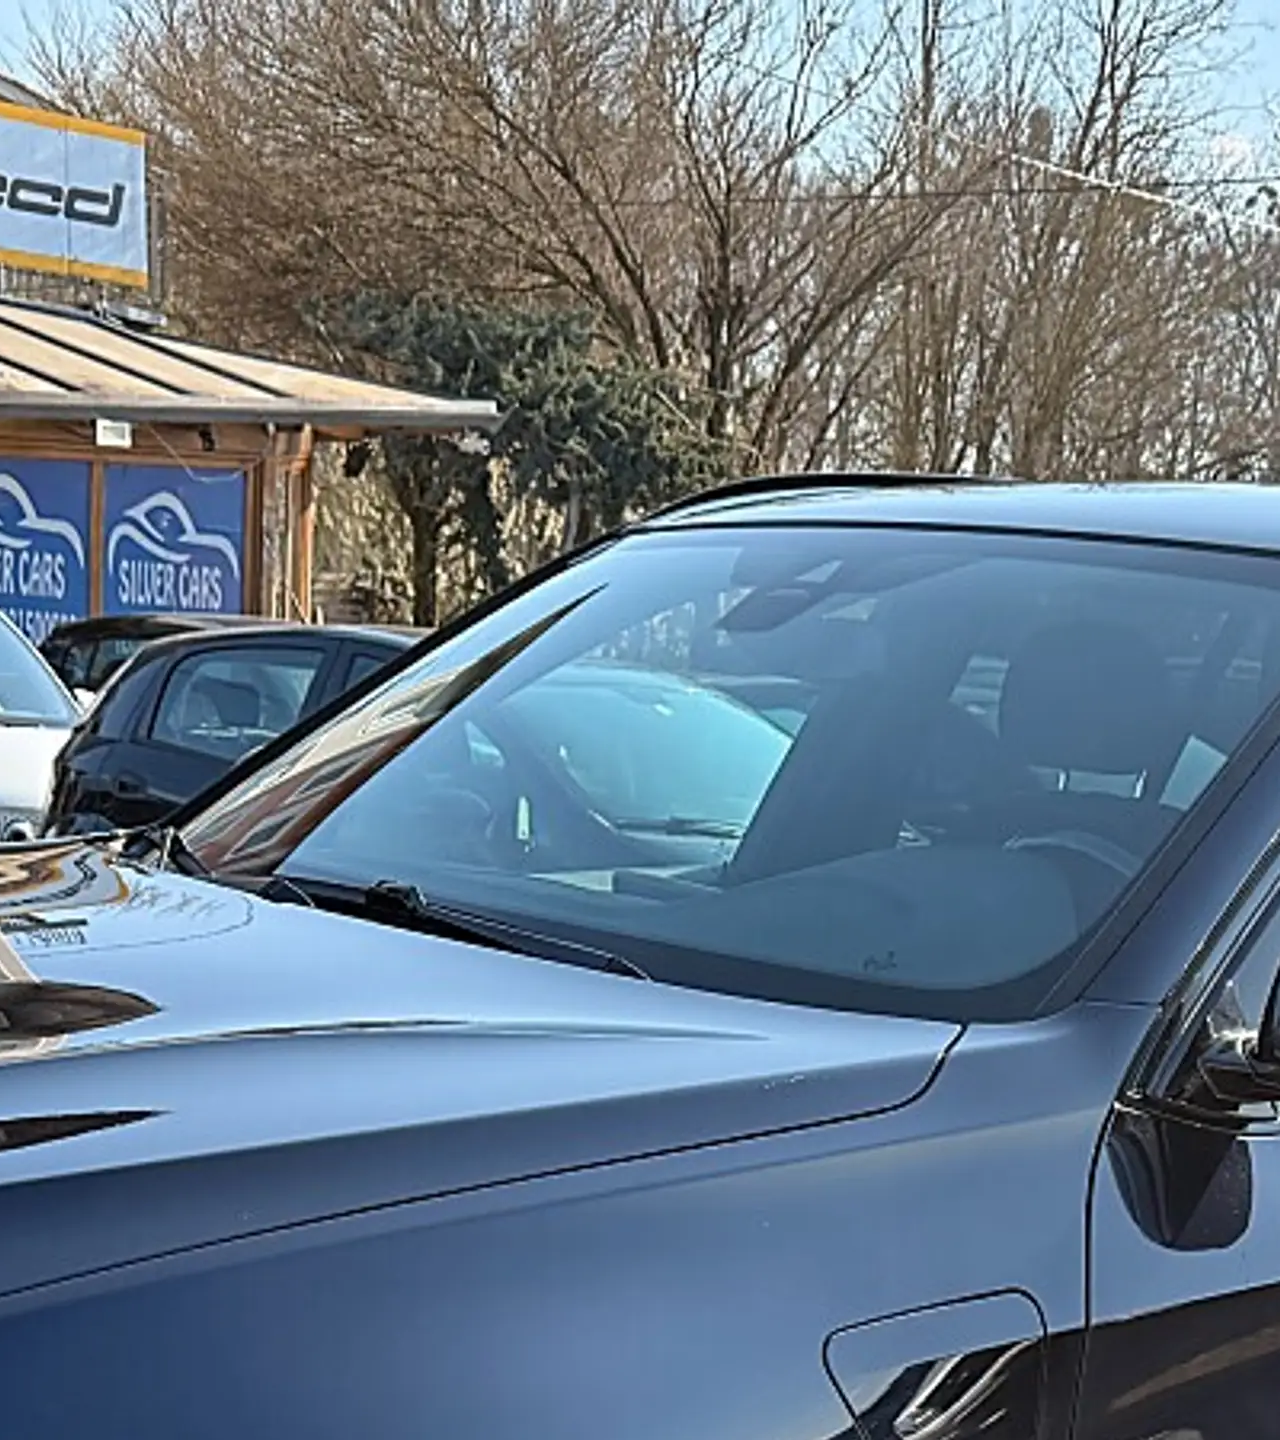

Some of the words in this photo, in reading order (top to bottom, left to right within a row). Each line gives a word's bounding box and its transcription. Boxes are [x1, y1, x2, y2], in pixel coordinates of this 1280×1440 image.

[17, 548, 66, 600] CARS
[119, 559, 175, 606] SILVER
[177, 563, 222, 612] CARS
